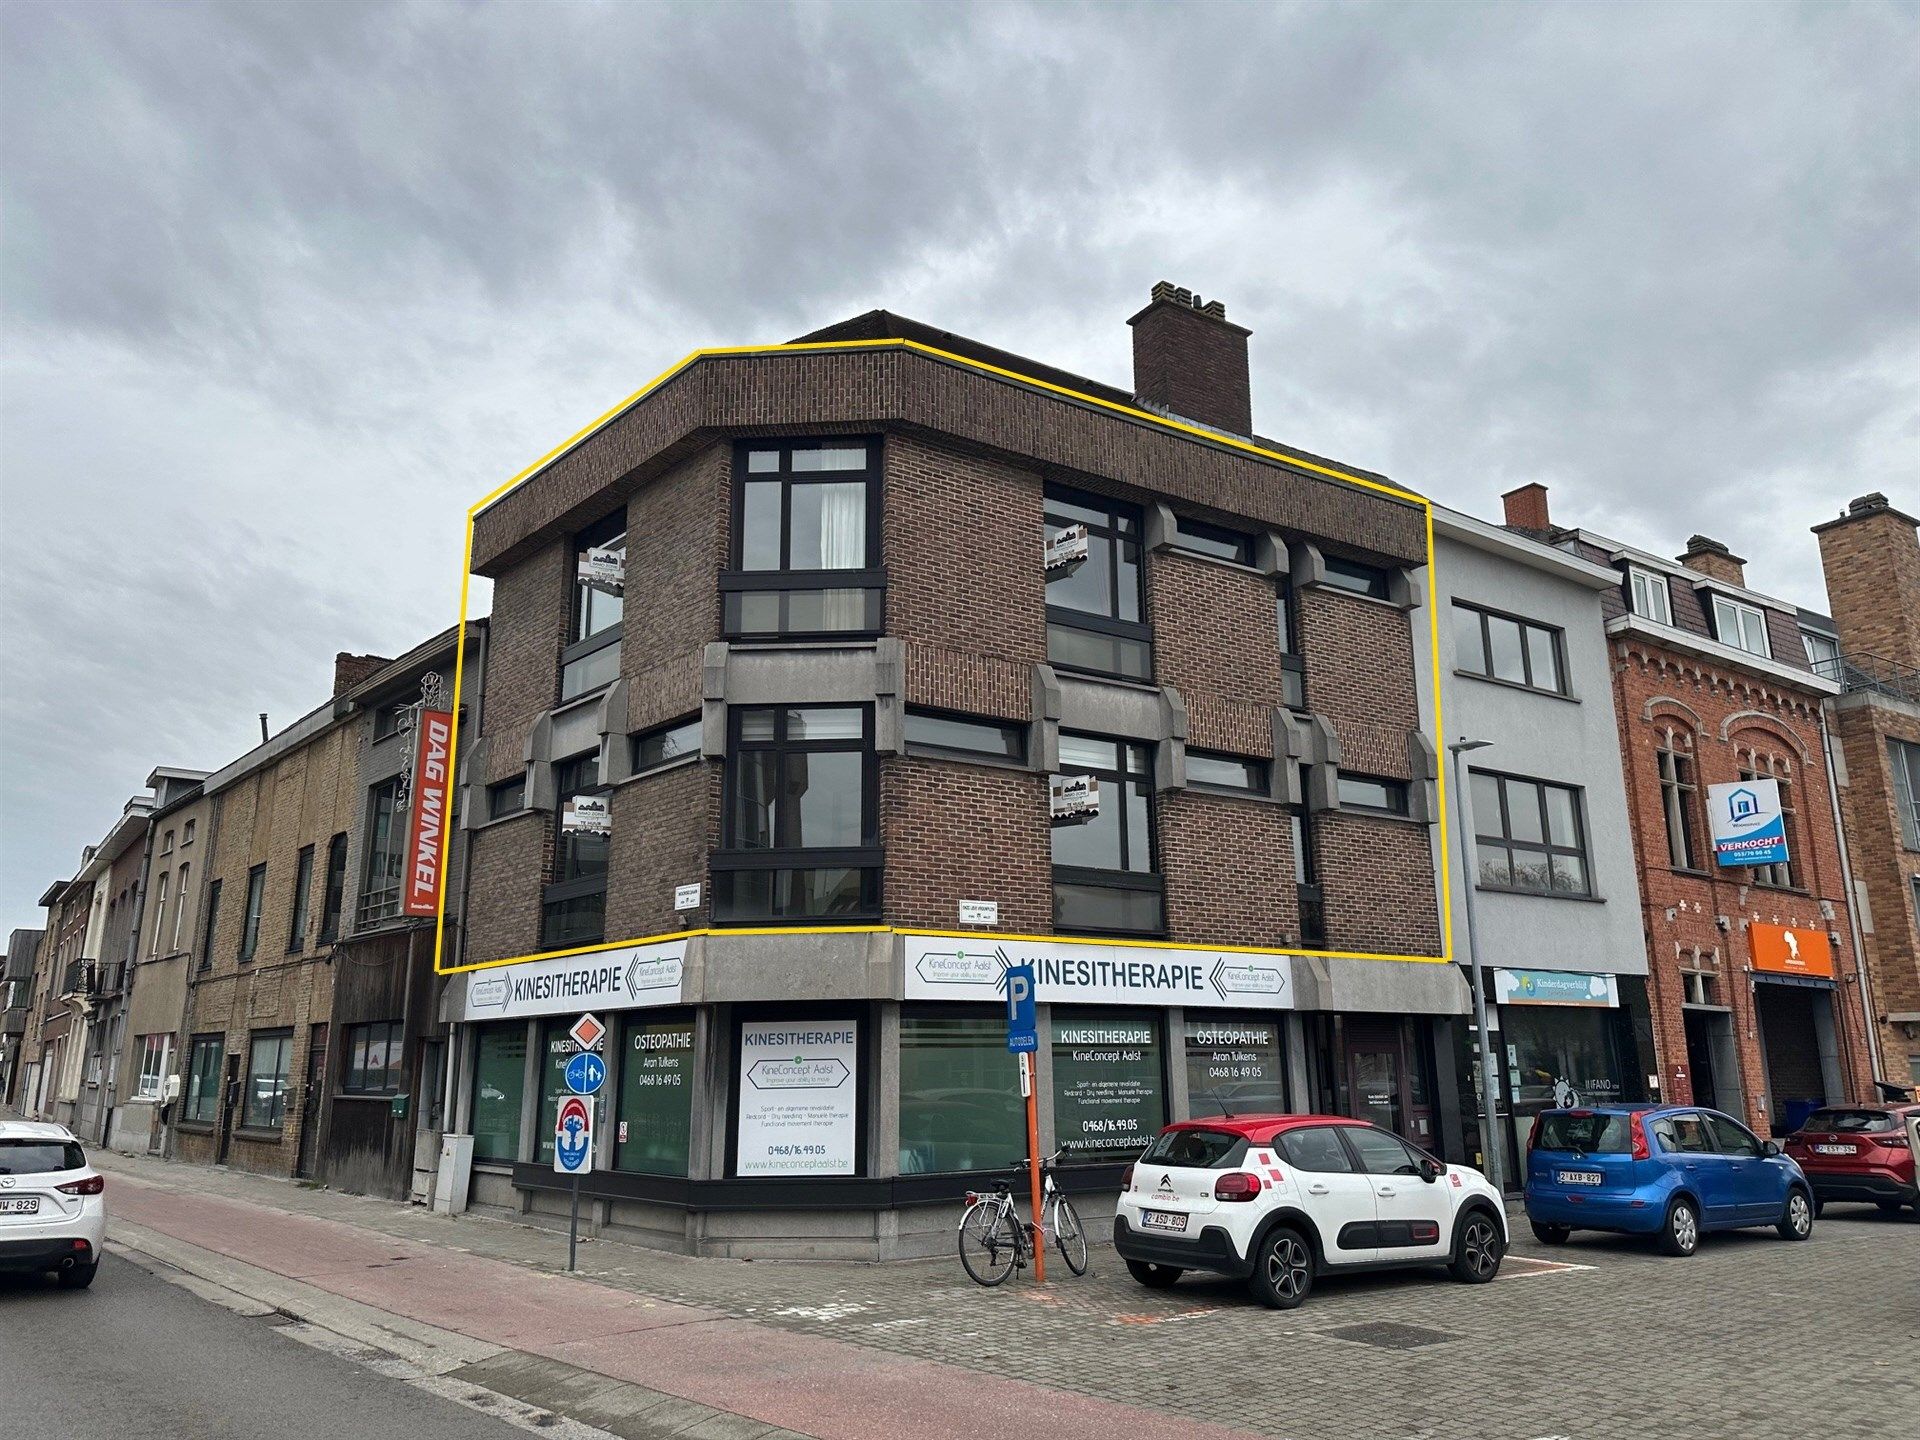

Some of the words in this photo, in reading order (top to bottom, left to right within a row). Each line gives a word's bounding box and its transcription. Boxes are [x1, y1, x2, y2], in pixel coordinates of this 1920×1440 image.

[424, 719, 449, 783] DAG
[414, 787, 443, 898] WINKEL
[1720, 836, 1780, 851] VERKOCHT
[929, 958, 971, 971] KineConcept
[974, 960, 991, 970] Aalst
[514, 967, 622, 1001] KINESITHERAPIE
[1010, 976, 1029, 1020] P
[634, 1032, 691, 1049] OSTEOPATHIE
[745, 1031, 854, 1046] KINESITHERAPIE
[1061, 1030, 1151, 1043] KINESITHERAPIE
[1197, 1030, 1268, 1044] OSTEOPATHIE
[643, 1057, 657, 1067] Aran
[658, 1056, 679, 1067] Tulkens
[1072, 1050, 1120, 1063] KineConcept
[1122, 1050, 1142, 1061] Aalst
[1212, 1051, 1230, 1061] Aran
[1231, 1051, 1257, 1061] Tulkens
[761, 1064, 811, 1076] KineConcept
[814, 1064, 834, 1074] Aalst
[1209, 1067, 1229, 1077] 0468
[1230, 1067, 1239, 1077] 16
[1240, 1067, 1250, 1077] 49
[1251, 1067, 1262, 1077] 05
[640, 1074, 655, 1085] 0468
[656, 1074, 663, 1085] 16
[663, 1074, 672, 1085] 49
[672, 1073, 681, 1085] 05
[744, 1159, 848, 1170] www.kineconceptaalst.be
